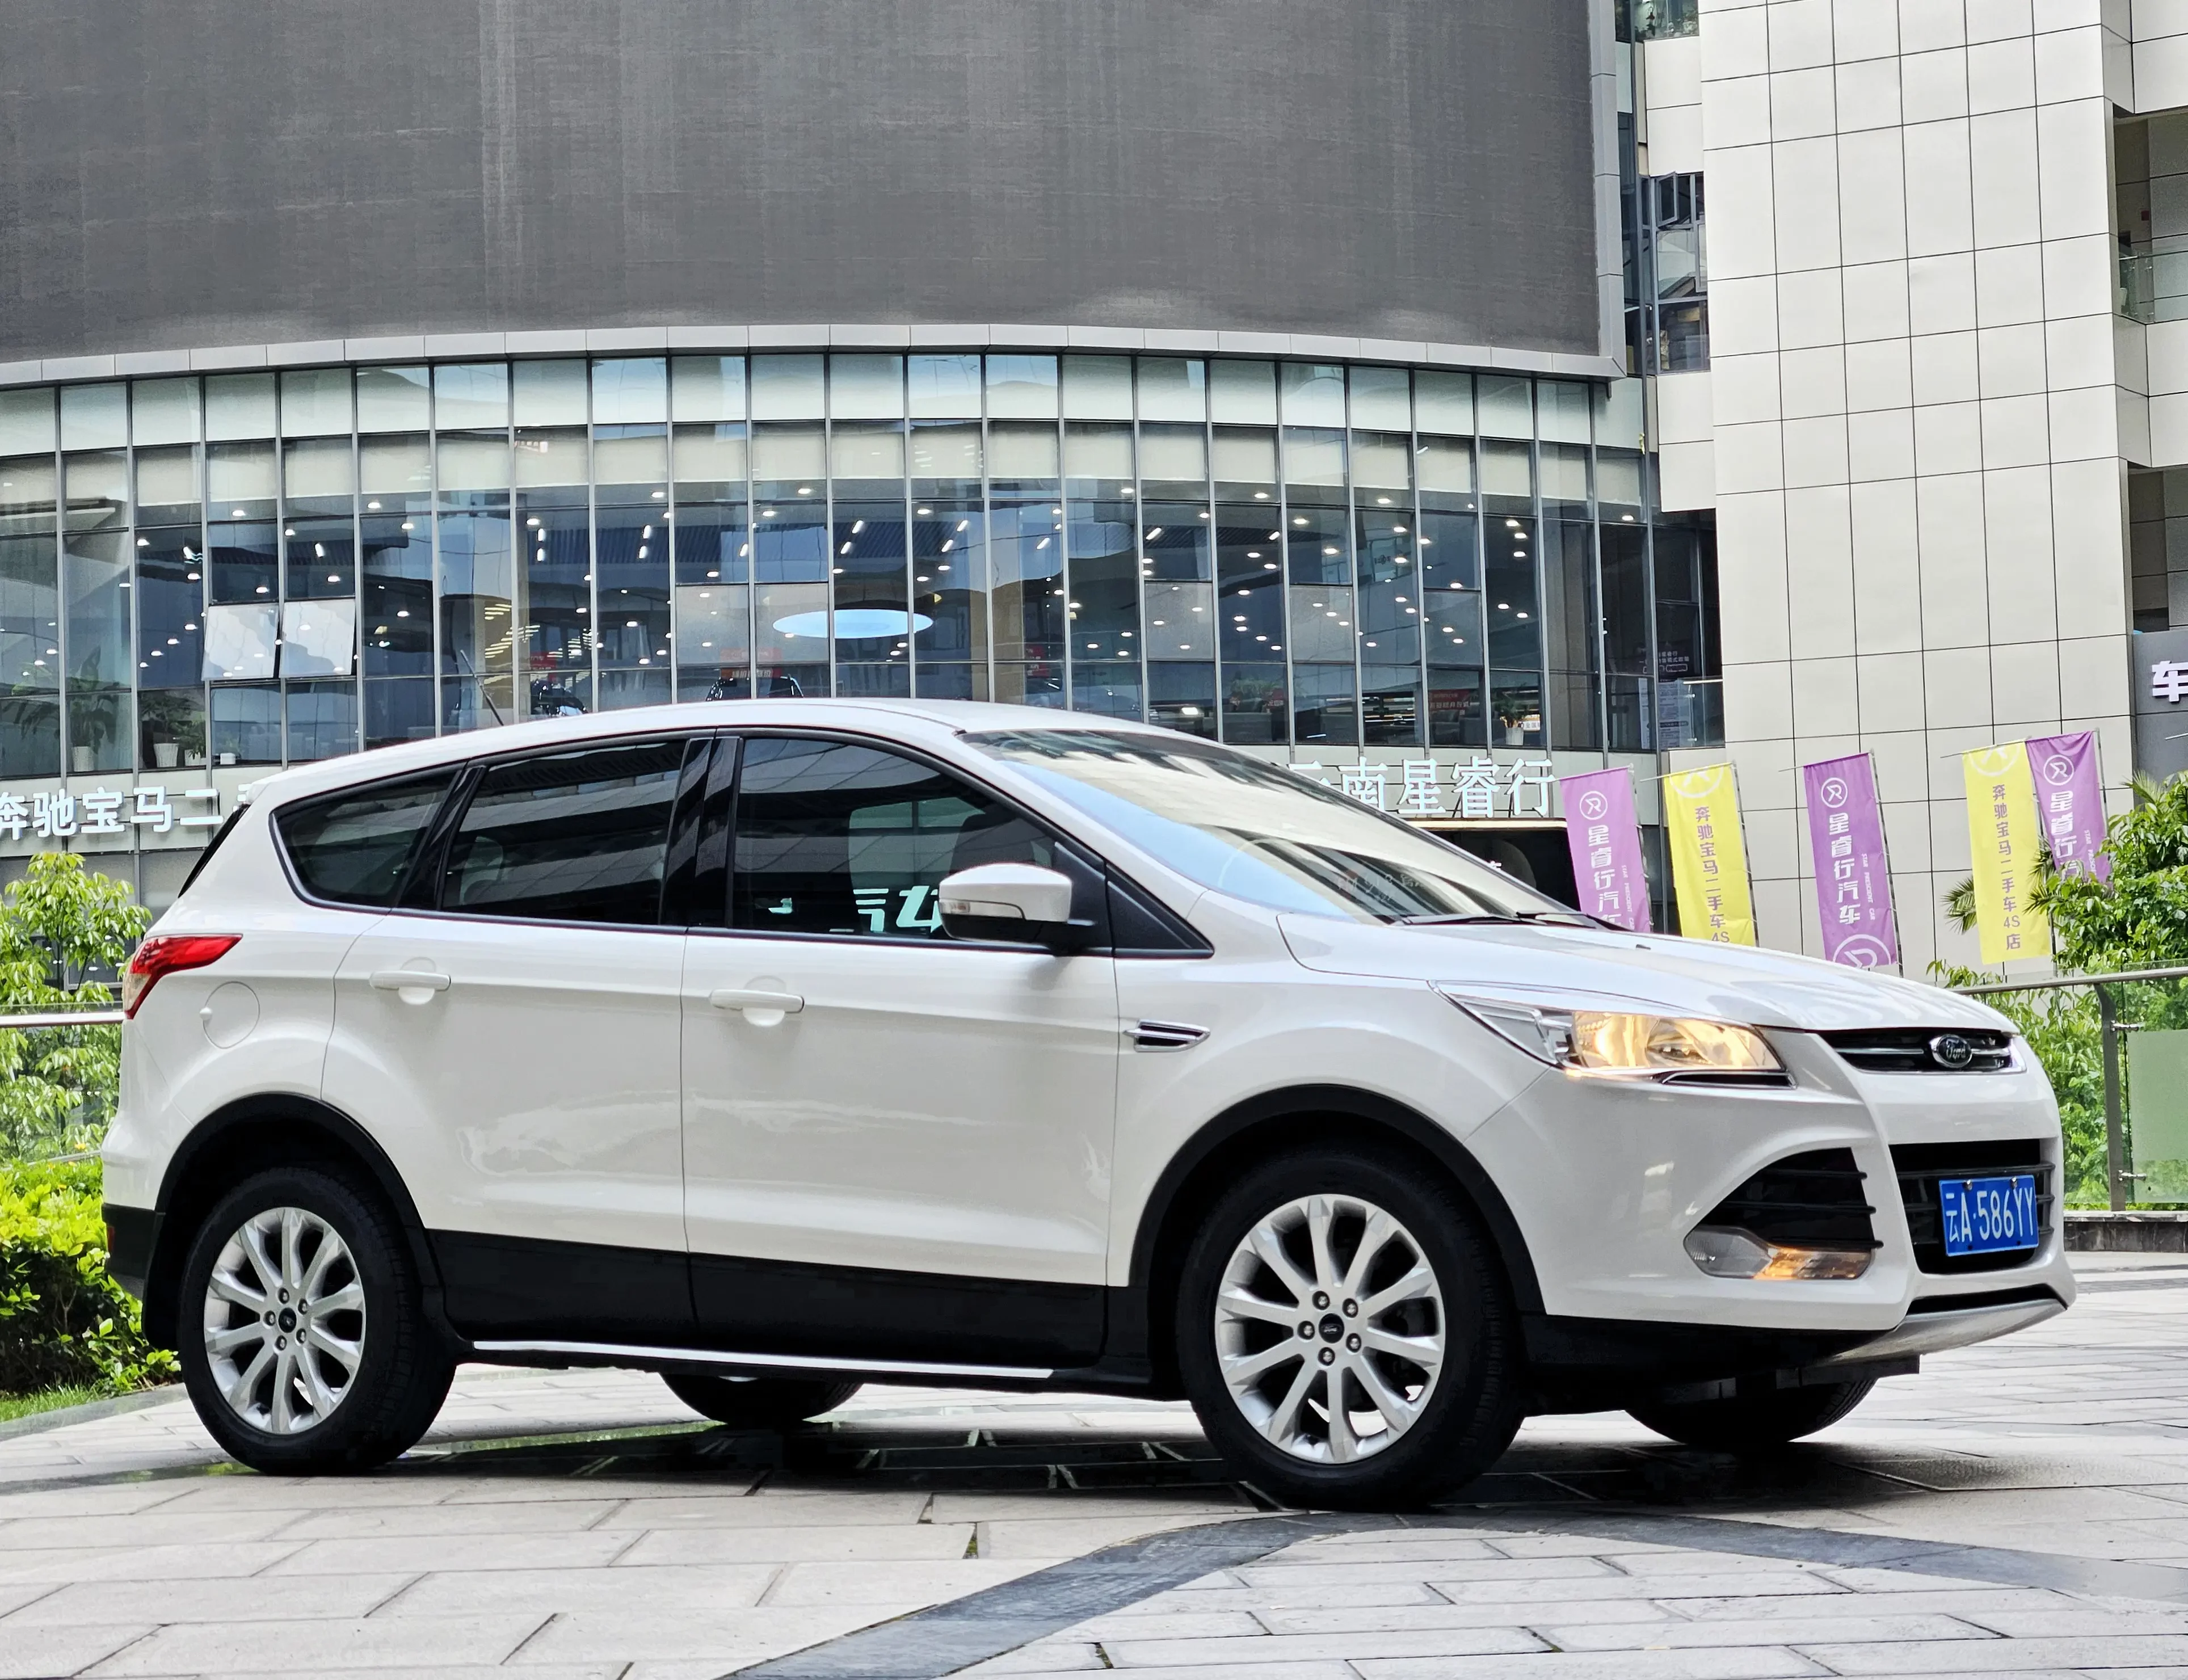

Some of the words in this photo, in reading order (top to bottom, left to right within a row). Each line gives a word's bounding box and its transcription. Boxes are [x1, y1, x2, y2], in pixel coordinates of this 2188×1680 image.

[2151, 660, 2188, 702] 车
[0, 784, 251, 840] 奔驰宝马二
[1829, 812, 1861, 924] 星睿行汽车
[1992, 784, 2021, 950] 奔驰宝马二手车4S店
[1946, 1038, 1966, 1060] Ford
